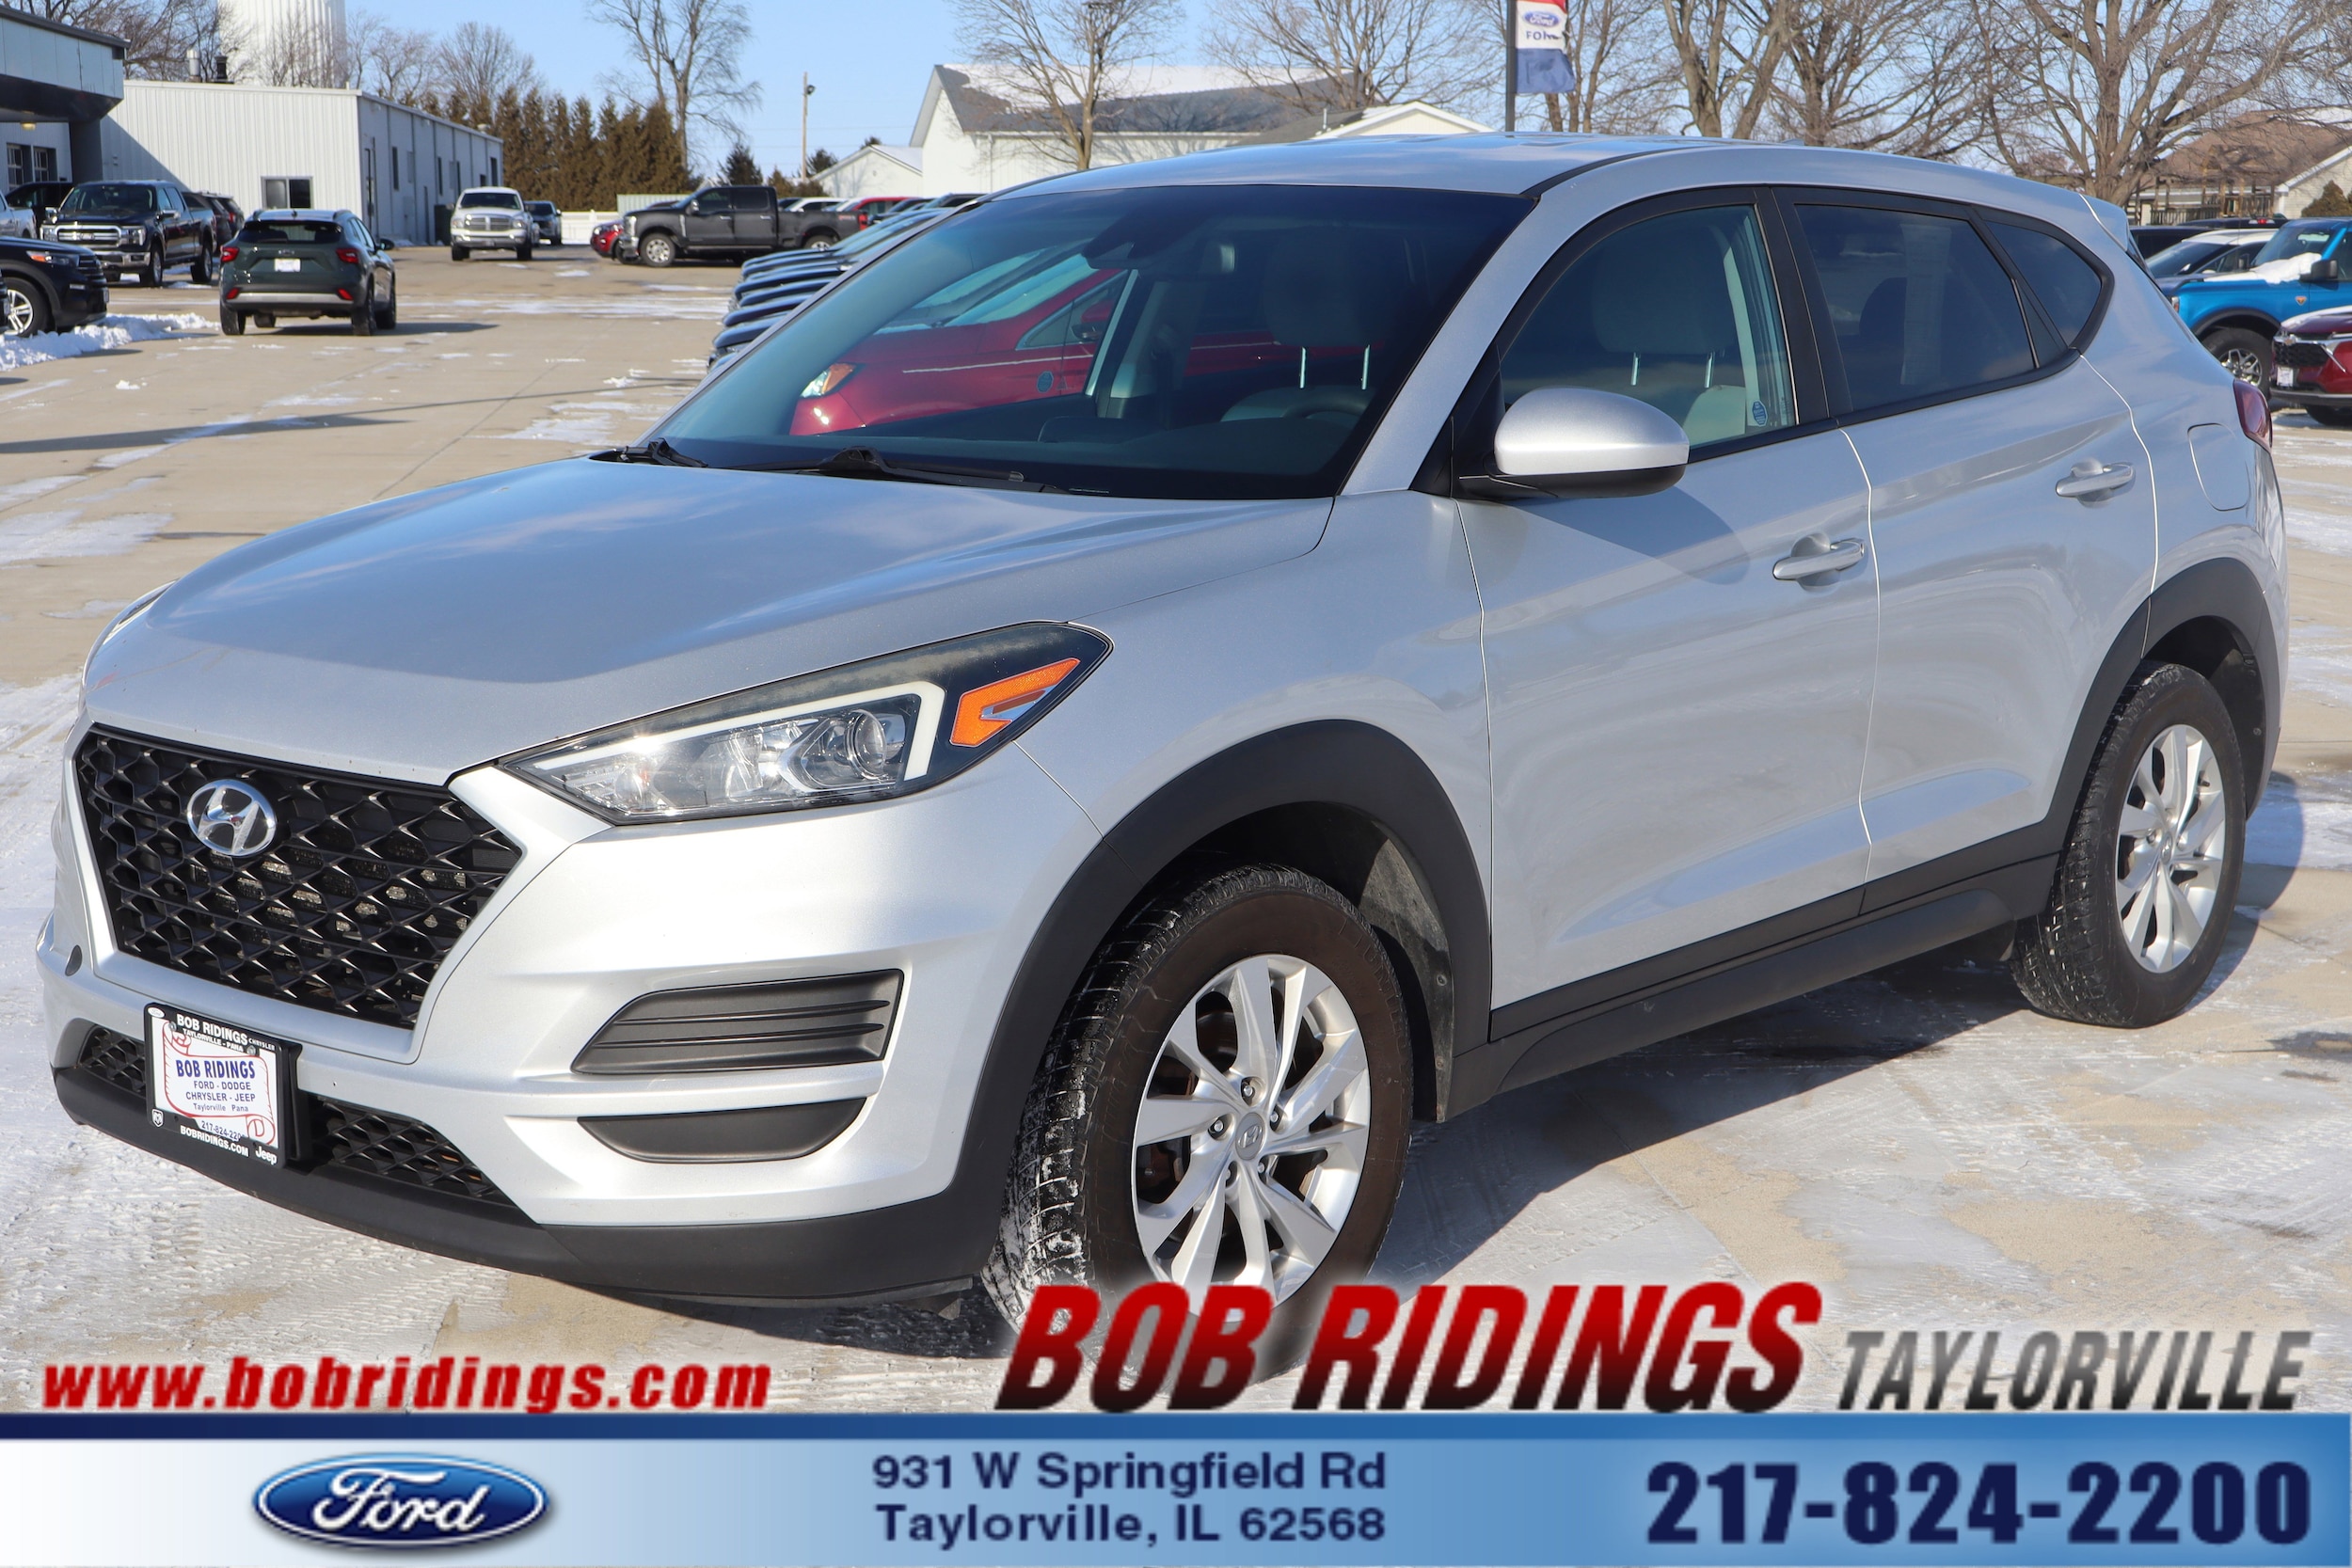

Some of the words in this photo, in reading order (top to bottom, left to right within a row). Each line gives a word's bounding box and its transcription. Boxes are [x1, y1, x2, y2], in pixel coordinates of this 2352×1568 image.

[1526, 31, 1560, 40] FO
[176, 1013, 200, 1031] BOB
[202, 1022, 248, 1045] RIDINGS
[248, 1037, 275, 1051] CHRYSLER
[183, 1027, 222, 1046] TAYLORVILLE
[226, 1041, 244, 1053] PANA
[176, 1059, 200, 1077] BOB
[204, 1060, 256, 1079] RIDINGS
[194, 1080, 215, 1089] FORD
[221, 1081, 251, 1090] DODGE
[185, 1091, 227, 1101] CHRYSLER
[234, 1093, 256, 1102] JEEP
[193, 1102, 226, 1112] Taylorville
[180, 1125, 249, 1157] BOBRIDINGS.COM
[255, 1146, 278, 1165] Jeep
